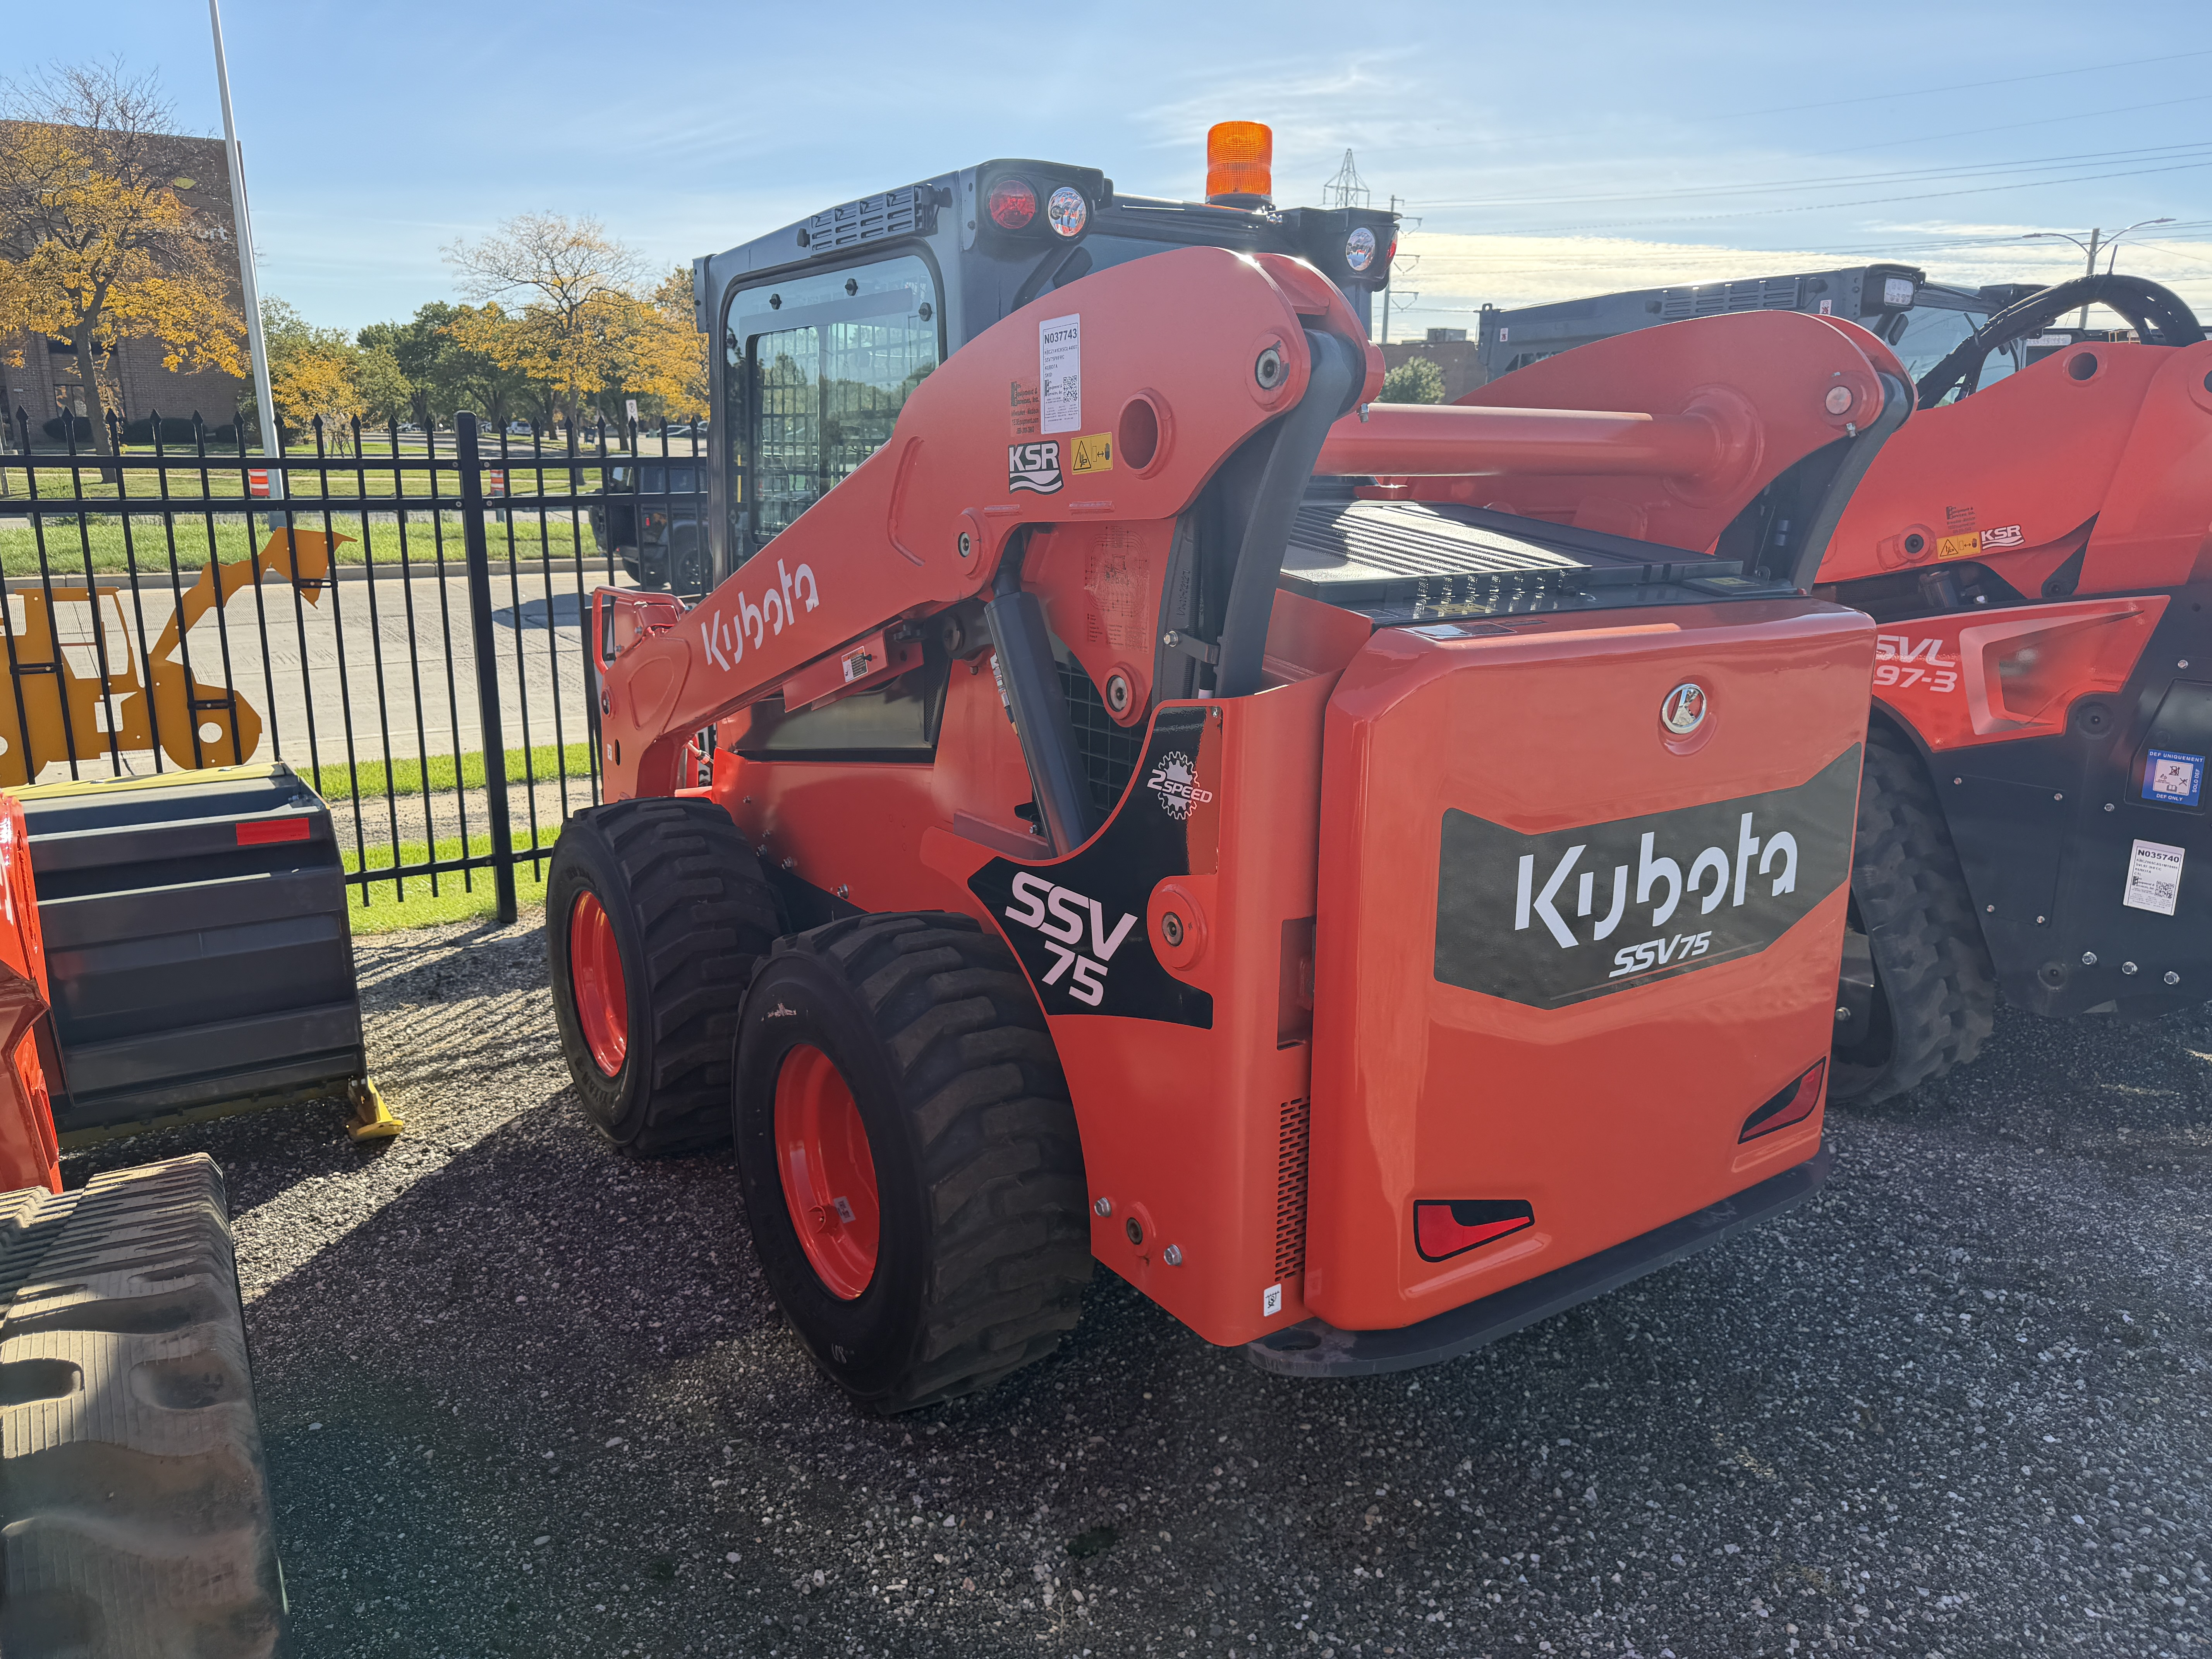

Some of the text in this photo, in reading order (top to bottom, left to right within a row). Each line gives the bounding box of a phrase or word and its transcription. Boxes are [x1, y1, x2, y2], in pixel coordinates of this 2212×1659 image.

[1044, 328, 1077, 344] N037743
[1009, 443, 1058, 472] KSR
[1981, 525, 2021, 542] KSR
[701, 558, 819, 672] Kubota
[1875, 634, 1956, 667] SVL
[1873, 665, 1958, 692] 97-3
[2163, 753, 2203, 763] UNIQUEMENT
[2138, 849, 2179, 863] N035740
[1515, 812, 1798, 948] Kubota
[1005, 871, 1138, 961] SSV
[1609, 931, 1712, 978] SSV75
[1042, 940, 1108, 1006] 75
